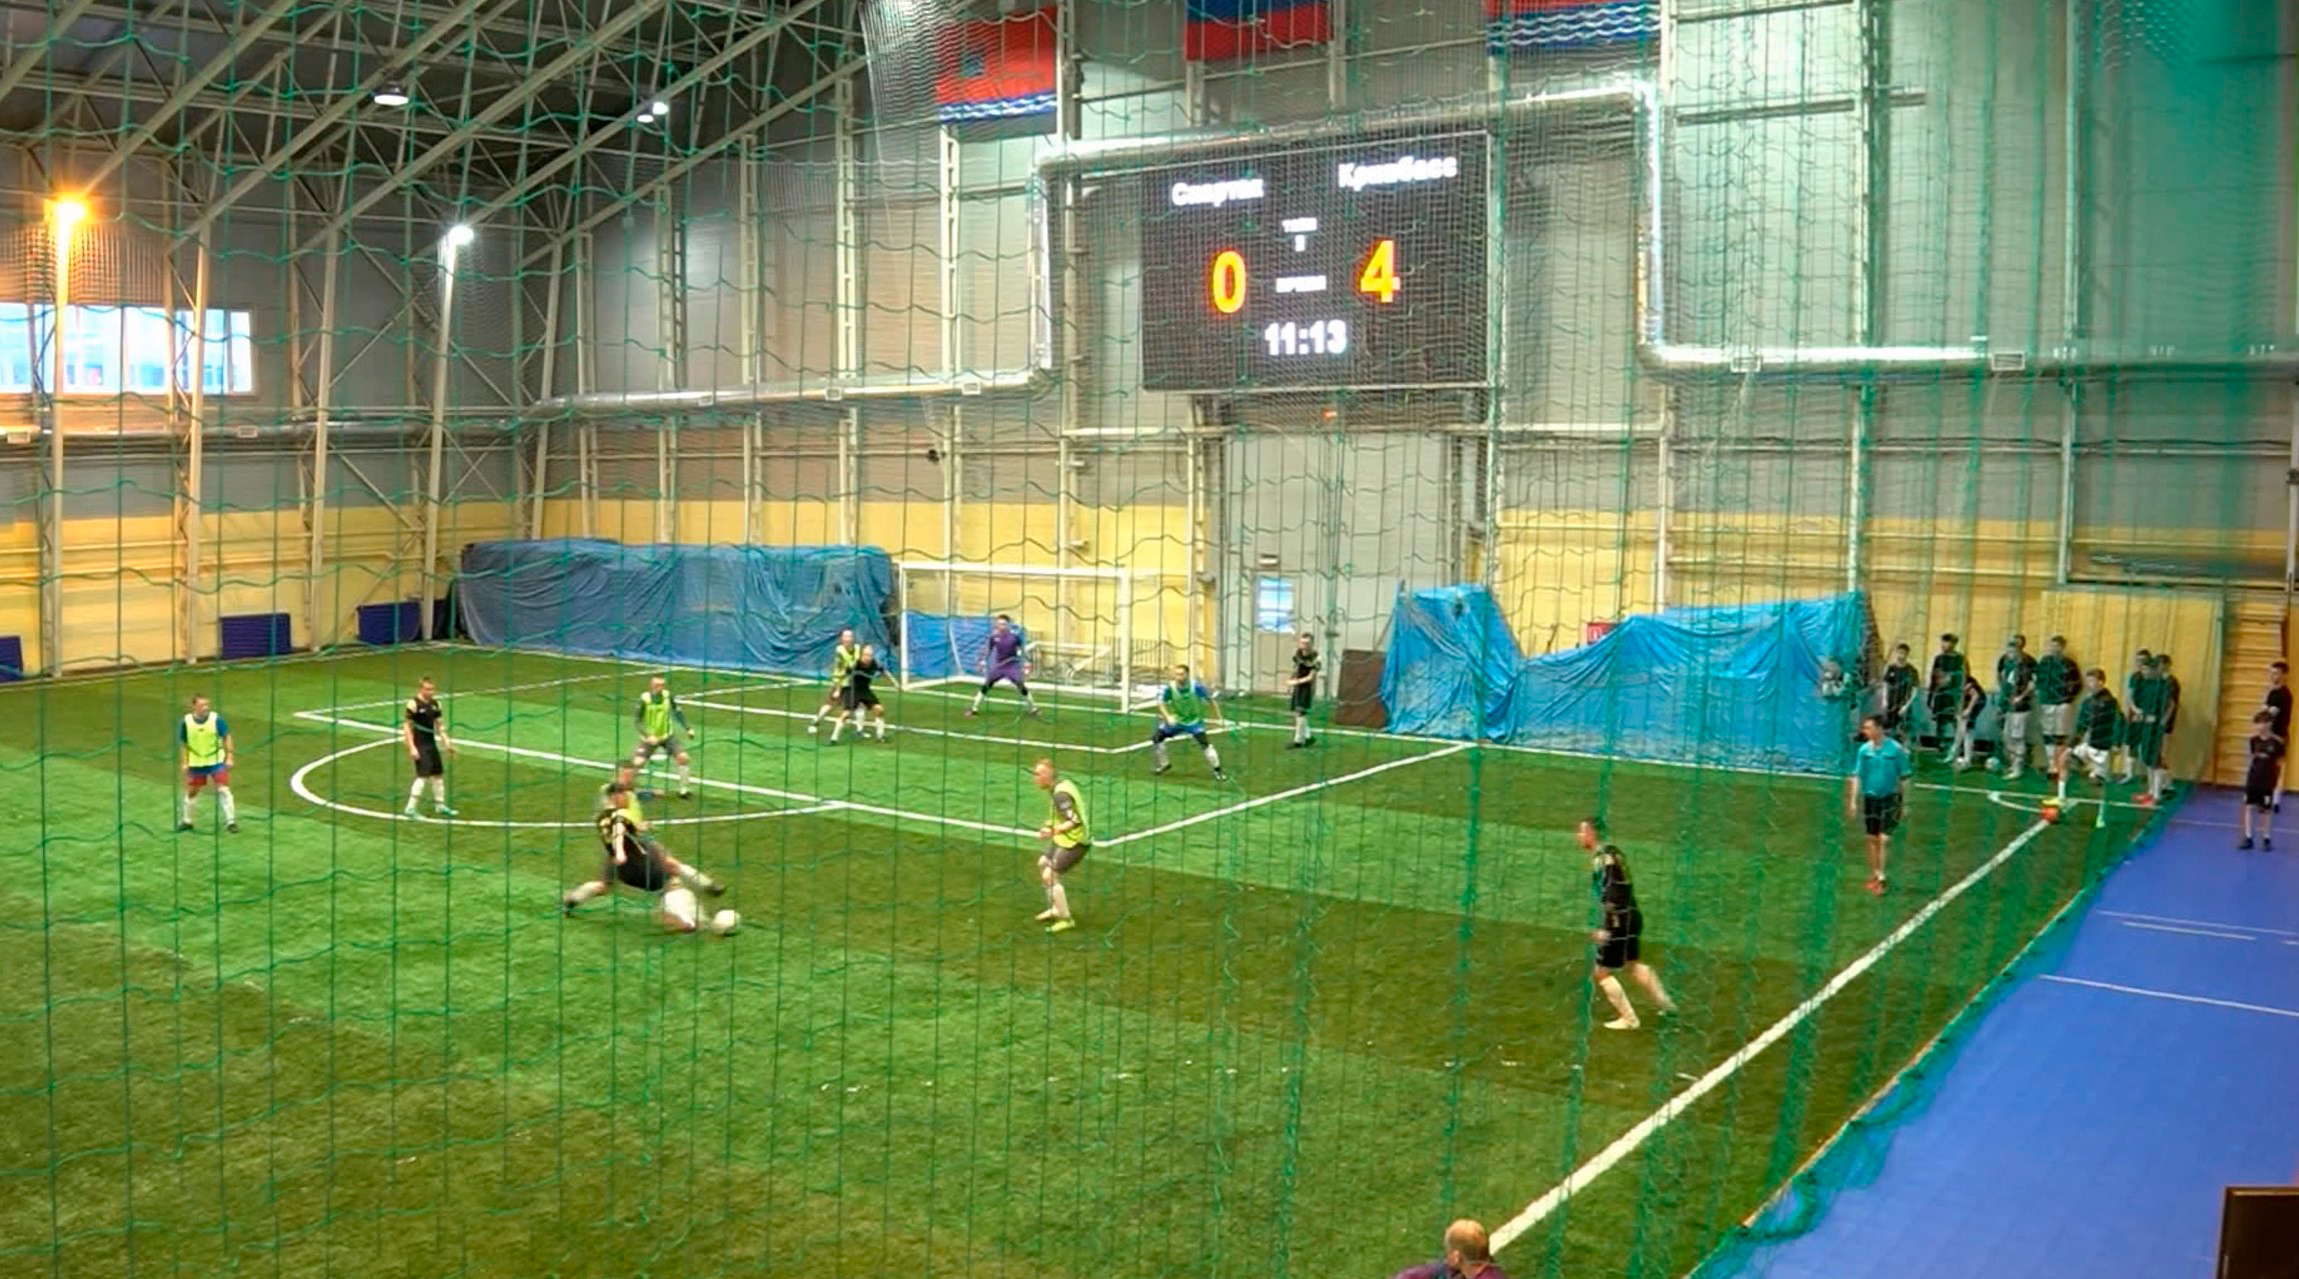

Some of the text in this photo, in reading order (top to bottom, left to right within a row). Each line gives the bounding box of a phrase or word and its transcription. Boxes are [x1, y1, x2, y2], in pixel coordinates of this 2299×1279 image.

[1210, 250, 1248, 315] 0
[1360, 239, 1401, 304] 4
[1264, 318, 1347, 356] 11:13
